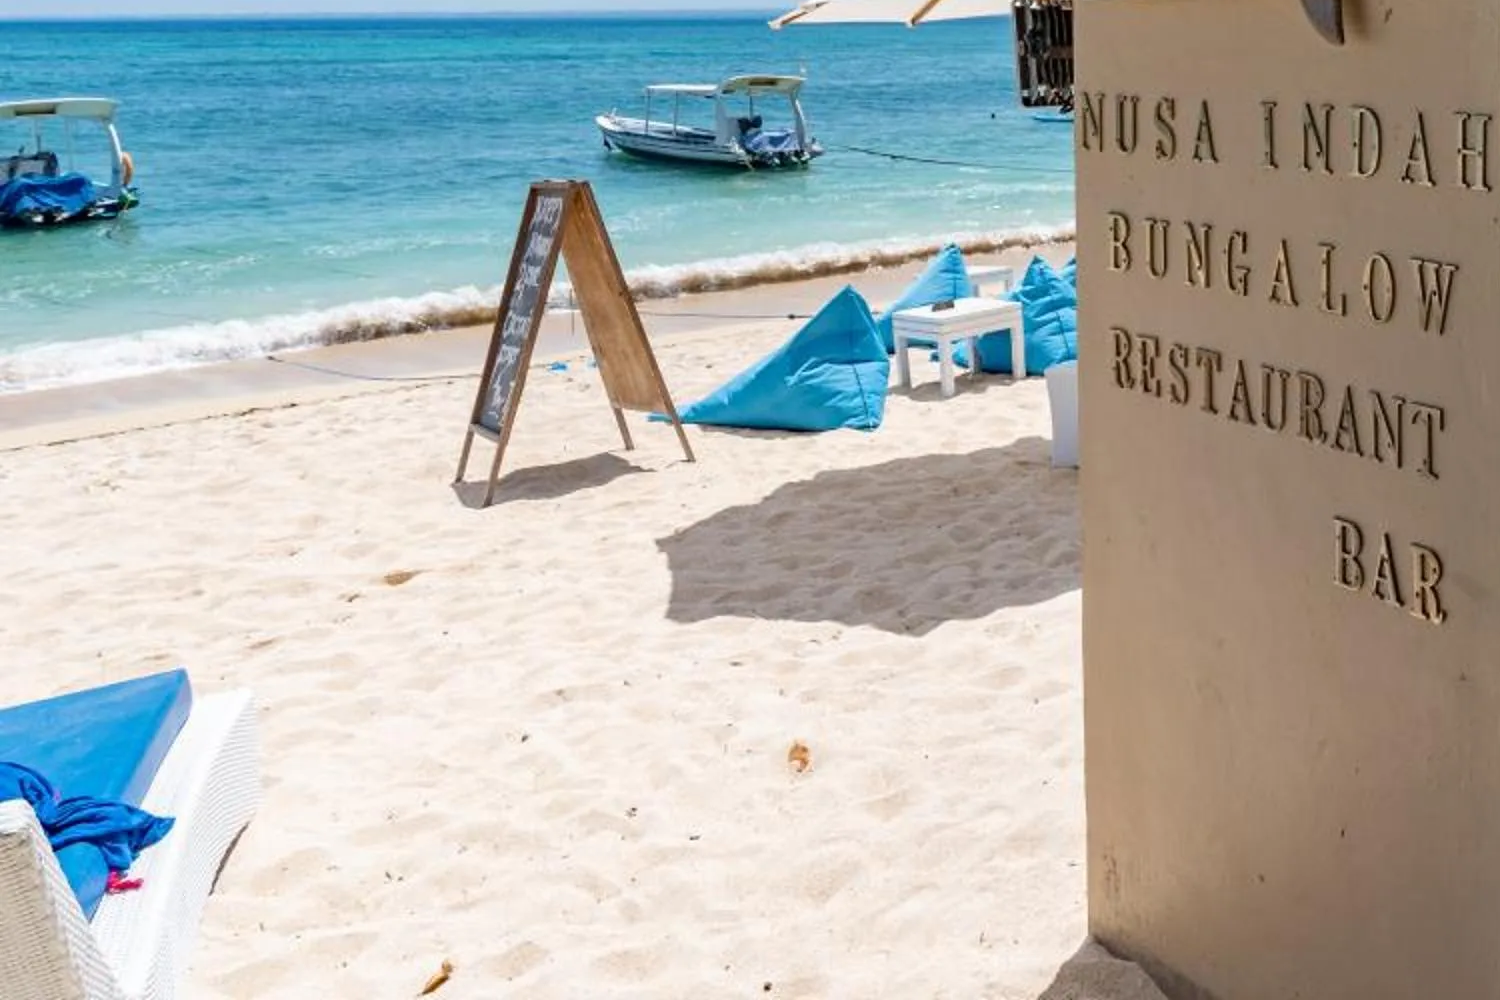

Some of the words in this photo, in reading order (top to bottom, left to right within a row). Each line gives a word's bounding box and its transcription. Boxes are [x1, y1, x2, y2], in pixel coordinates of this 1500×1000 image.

[1081, 91, 1219, 164] NUSA
[1260, 101, 1493, 192] INDAH
[1107, 211, 1459, 336] BUNGALOW
[1110, 326, 1445, 480] RESTAURANT
[1333, 515, 1447, 625] BAR
